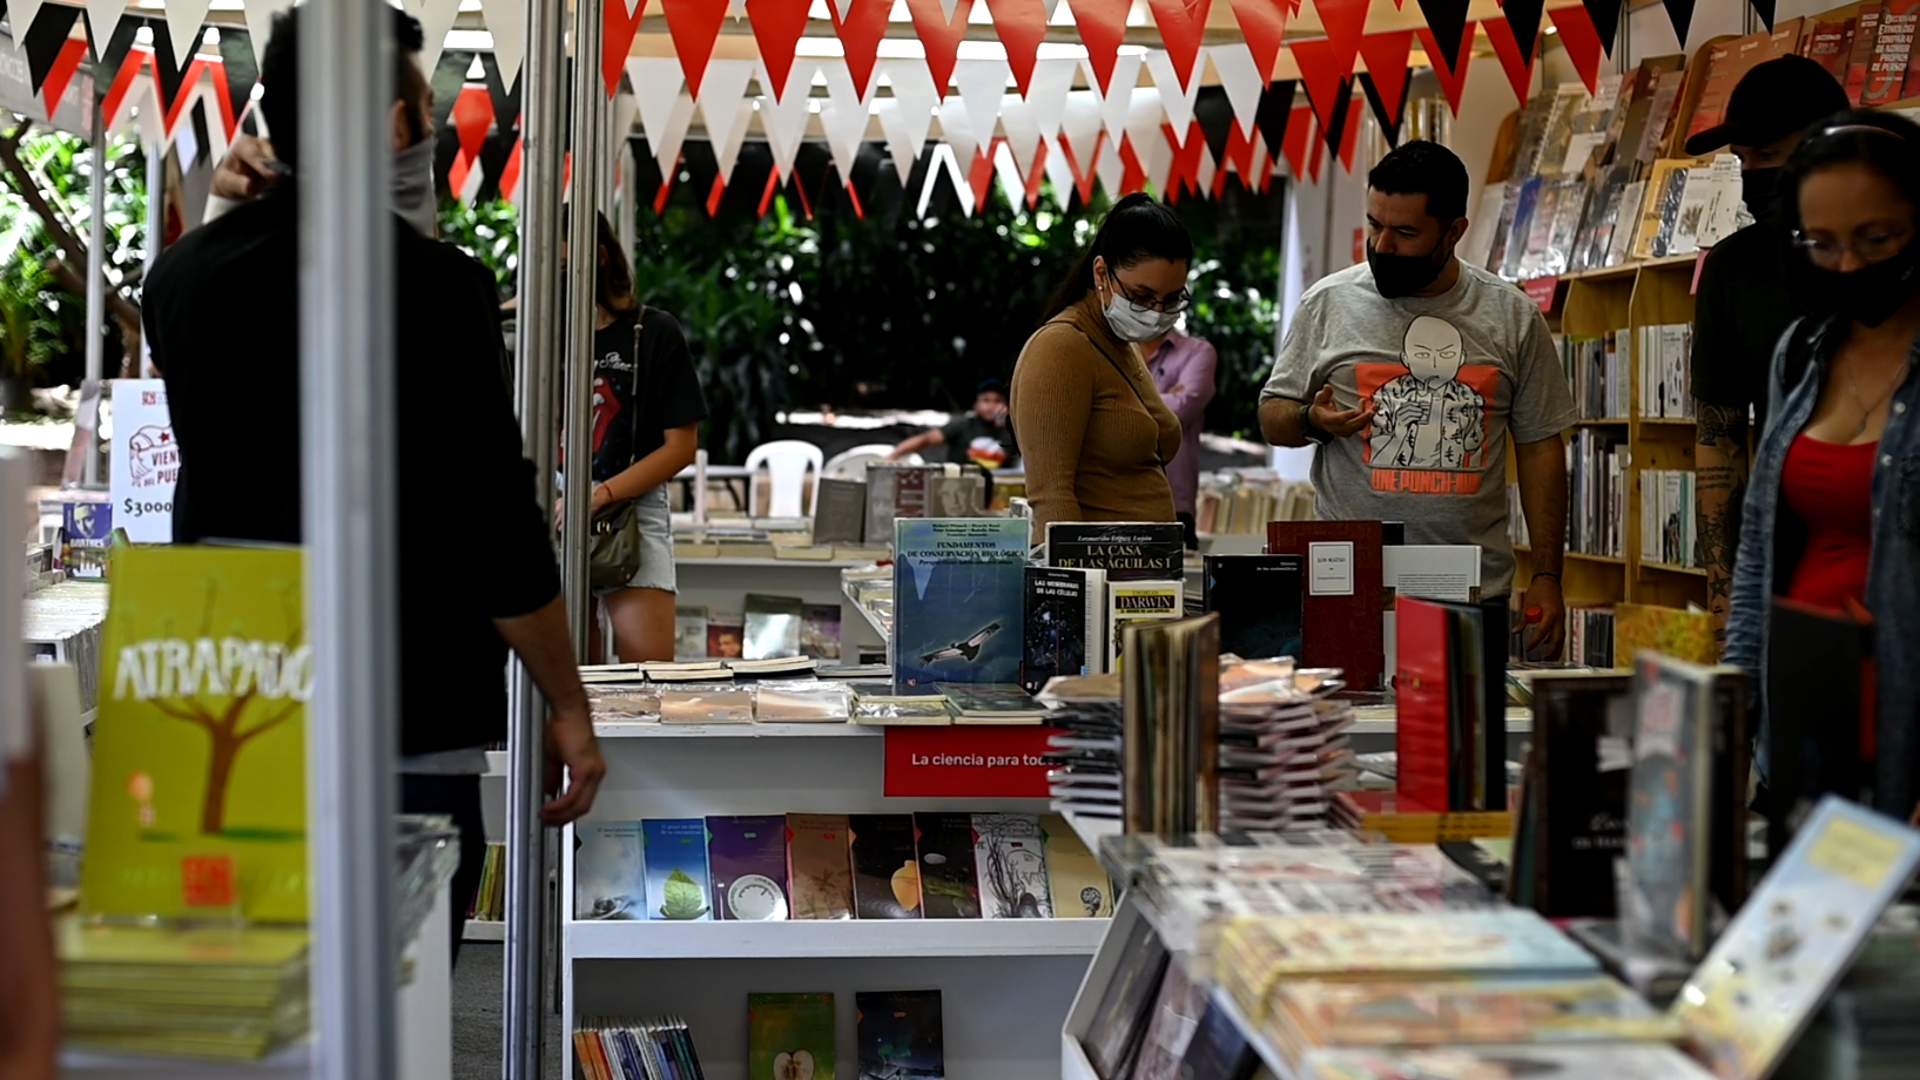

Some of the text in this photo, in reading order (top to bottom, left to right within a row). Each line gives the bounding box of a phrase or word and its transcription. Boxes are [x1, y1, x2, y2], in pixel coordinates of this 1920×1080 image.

[937, 541, 996, 549] FUNDAMENTOS
[1087, 545, 1141, 556] LA CASA
[1058, 558, 1075, 568] DE
[1079, 558, 1104, 568] LAS
[1120, 596, 1171, 608] DARWIN
[912, 753, 929, 766] La
[932, 752, 984, 766] ciencia
[987, 755, 1019, 768] para
